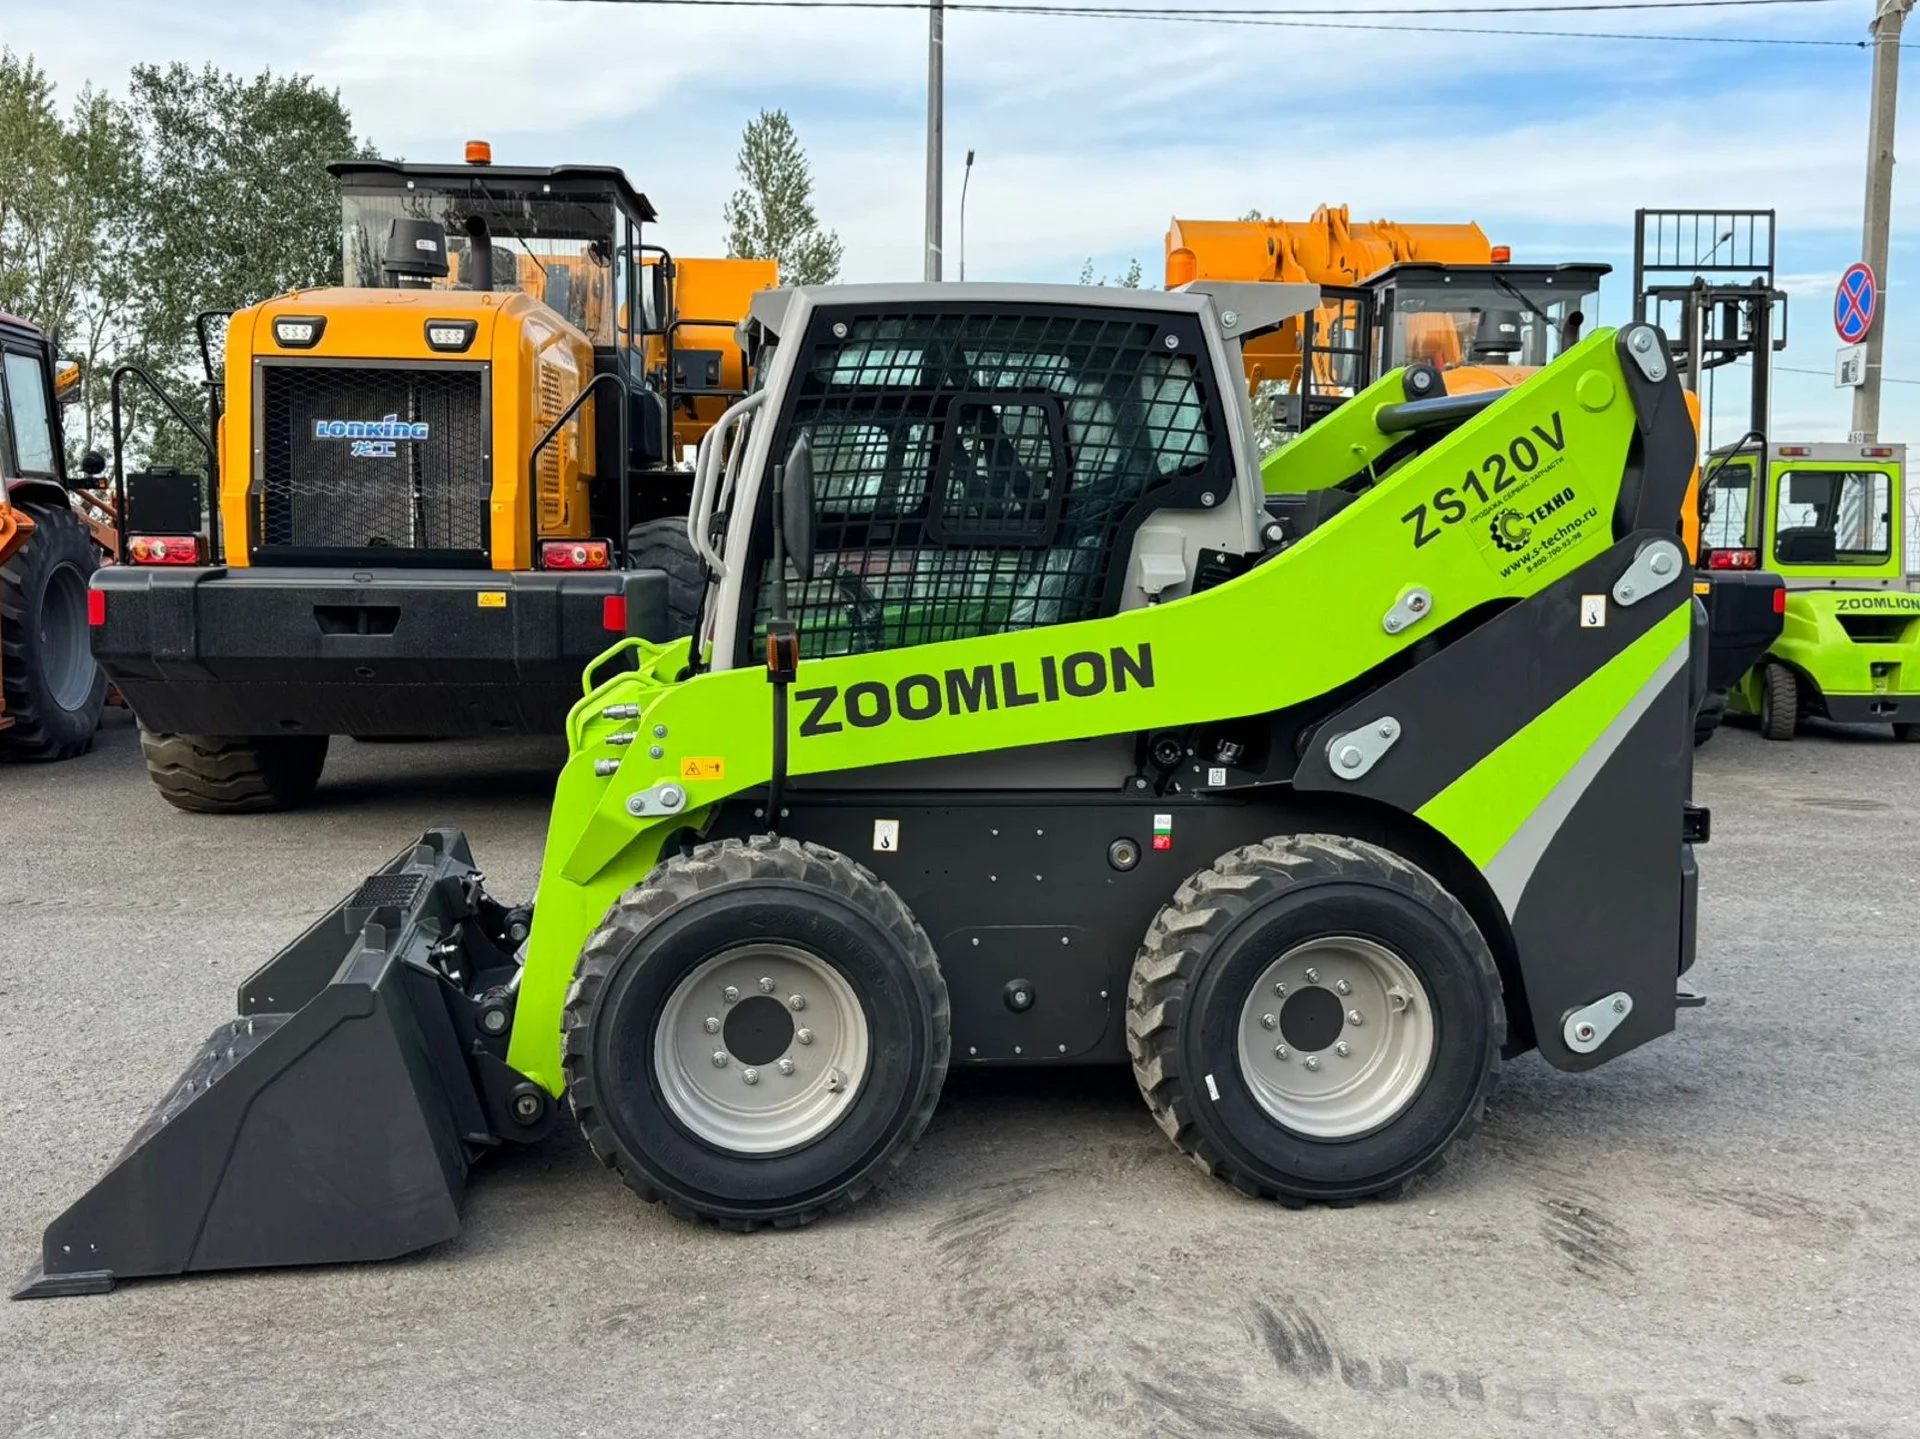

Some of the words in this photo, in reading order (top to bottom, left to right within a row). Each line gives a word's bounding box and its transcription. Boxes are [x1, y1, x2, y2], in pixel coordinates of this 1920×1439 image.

[350, 440, 396, 457] 龙工
[1401, 411, 1565, 549] ZS120V
[1470, 500, 1503, 524] ПРОДАЖА
[1503, 481, 1530, 502] СЕРВИС
[1530, 456, 1565, 483] ЗАПЧАСТИ
[1526, 487, 1576, 525] ТЕХНО
[1500, 507, 1598, 578] www.s-techno.ru
[1836, 597, 1920, 610] ZOOMLION
[795, 643, 1154, 737] ZOOMLION
